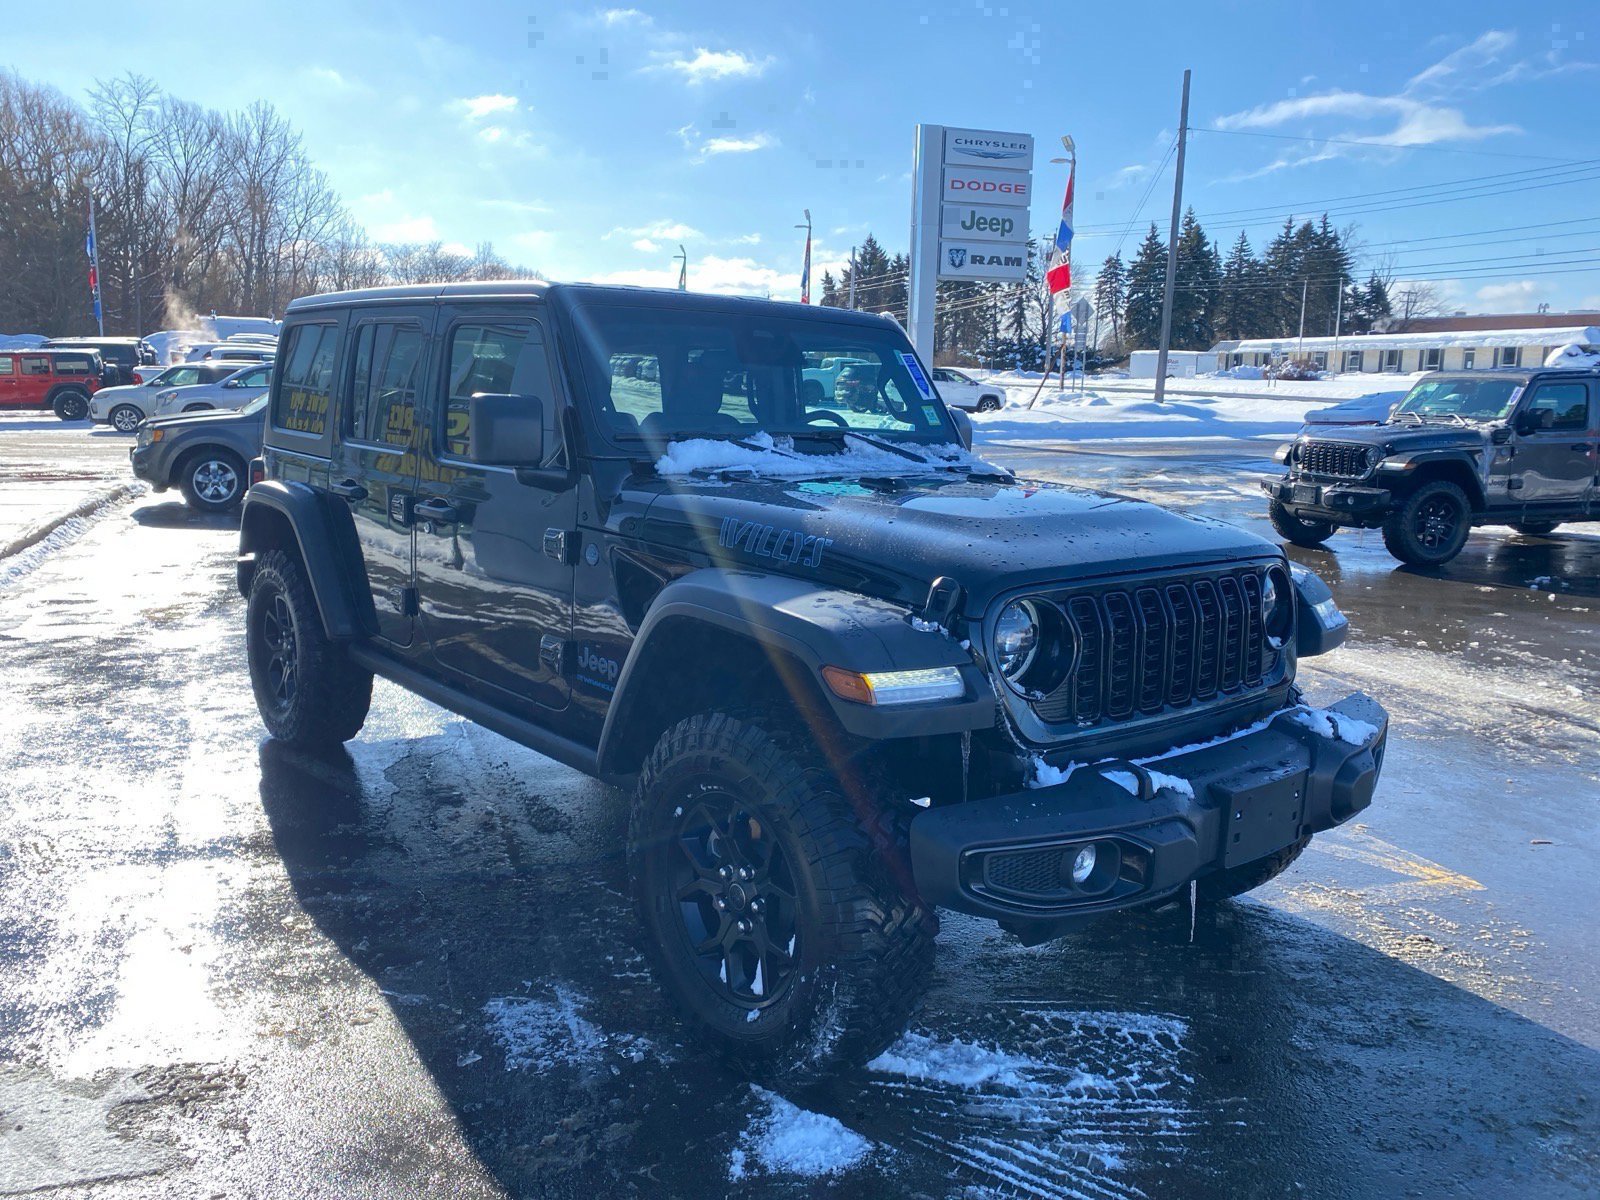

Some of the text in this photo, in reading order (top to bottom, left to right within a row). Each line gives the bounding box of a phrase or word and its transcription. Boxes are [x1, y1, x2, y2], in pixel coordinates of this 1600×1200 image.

[954, 138, 1027, 150] CHRYSLER
[950, 179, 1027, 195] DODGE
[960, 210, 1014, 237] Jeep
[970, 254, 1022, 267] RAM
[719, 516, 834, 568] WILLYS
[578, 647, 619, 681] Jeep
